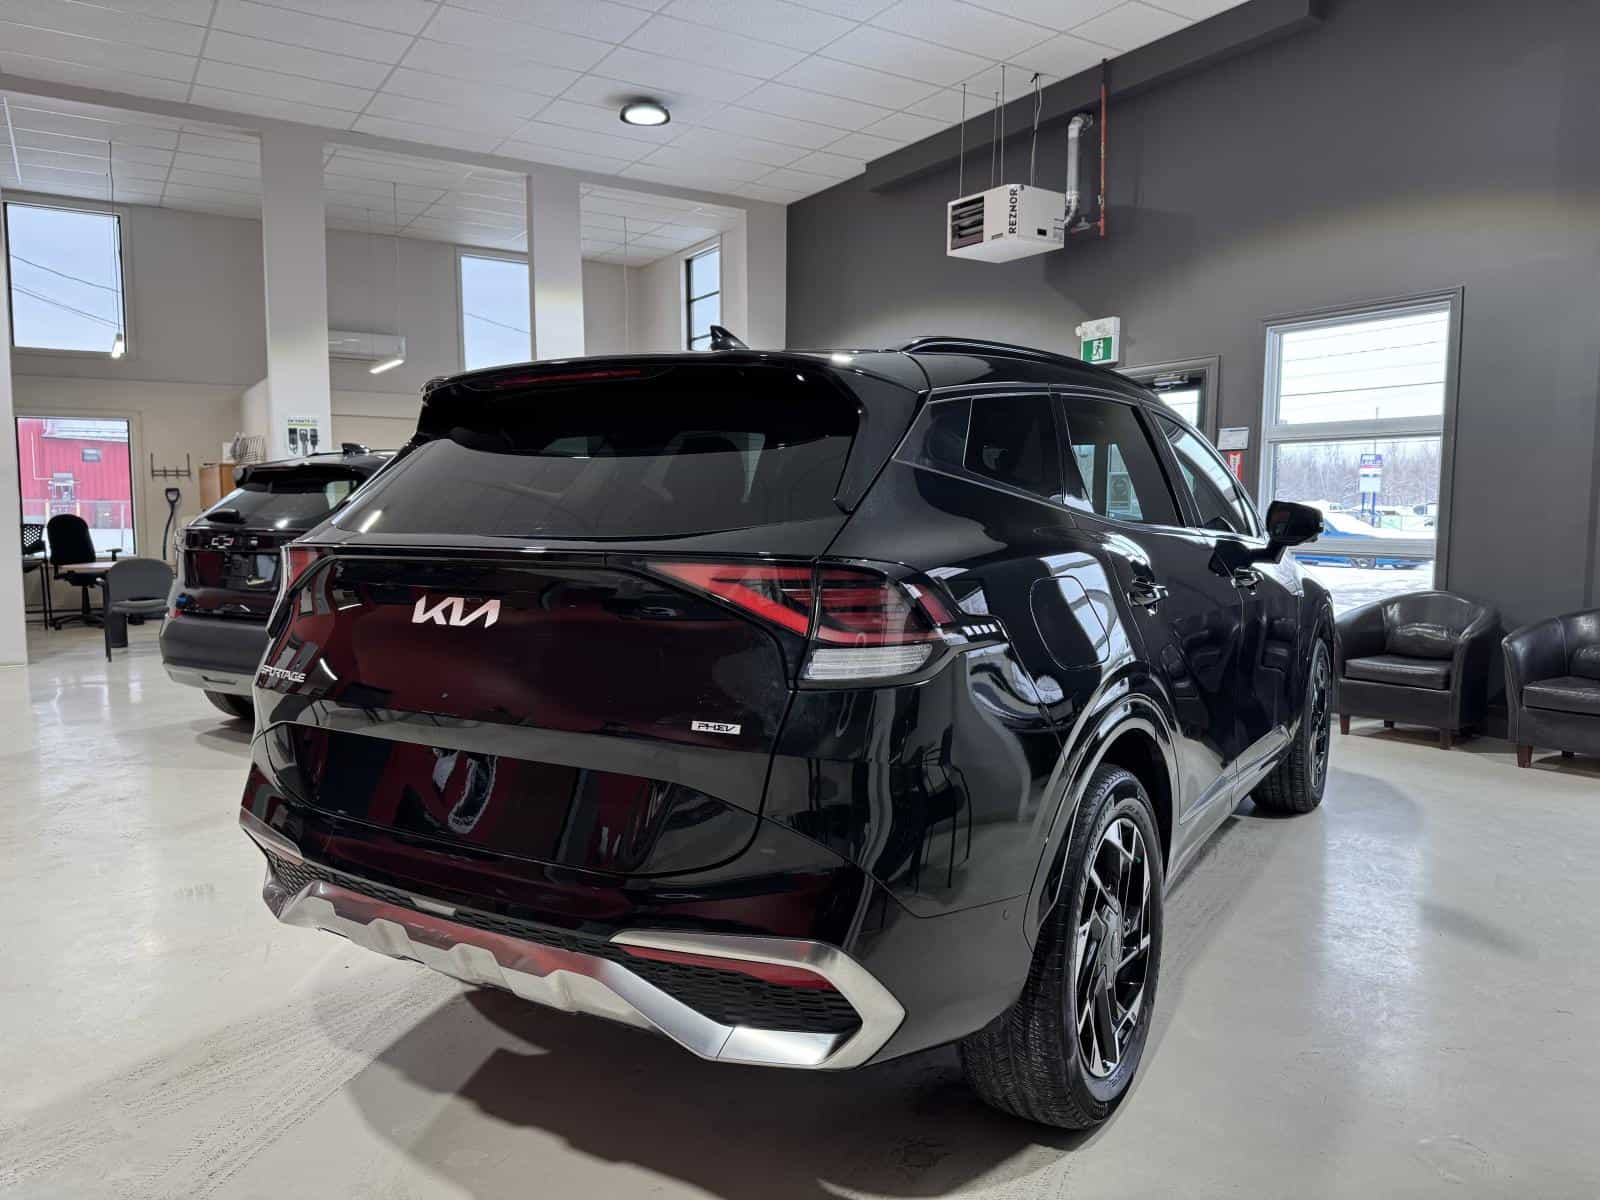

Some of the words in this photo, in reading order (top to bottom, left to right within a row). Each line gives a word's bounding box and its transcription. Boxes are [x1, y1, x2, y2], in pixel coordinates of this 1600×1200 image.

[1008, 188, 1018, 234] REZNOR
[412, 595, 501, 629] KIA
[696, 722, 737, 732] PHEV
